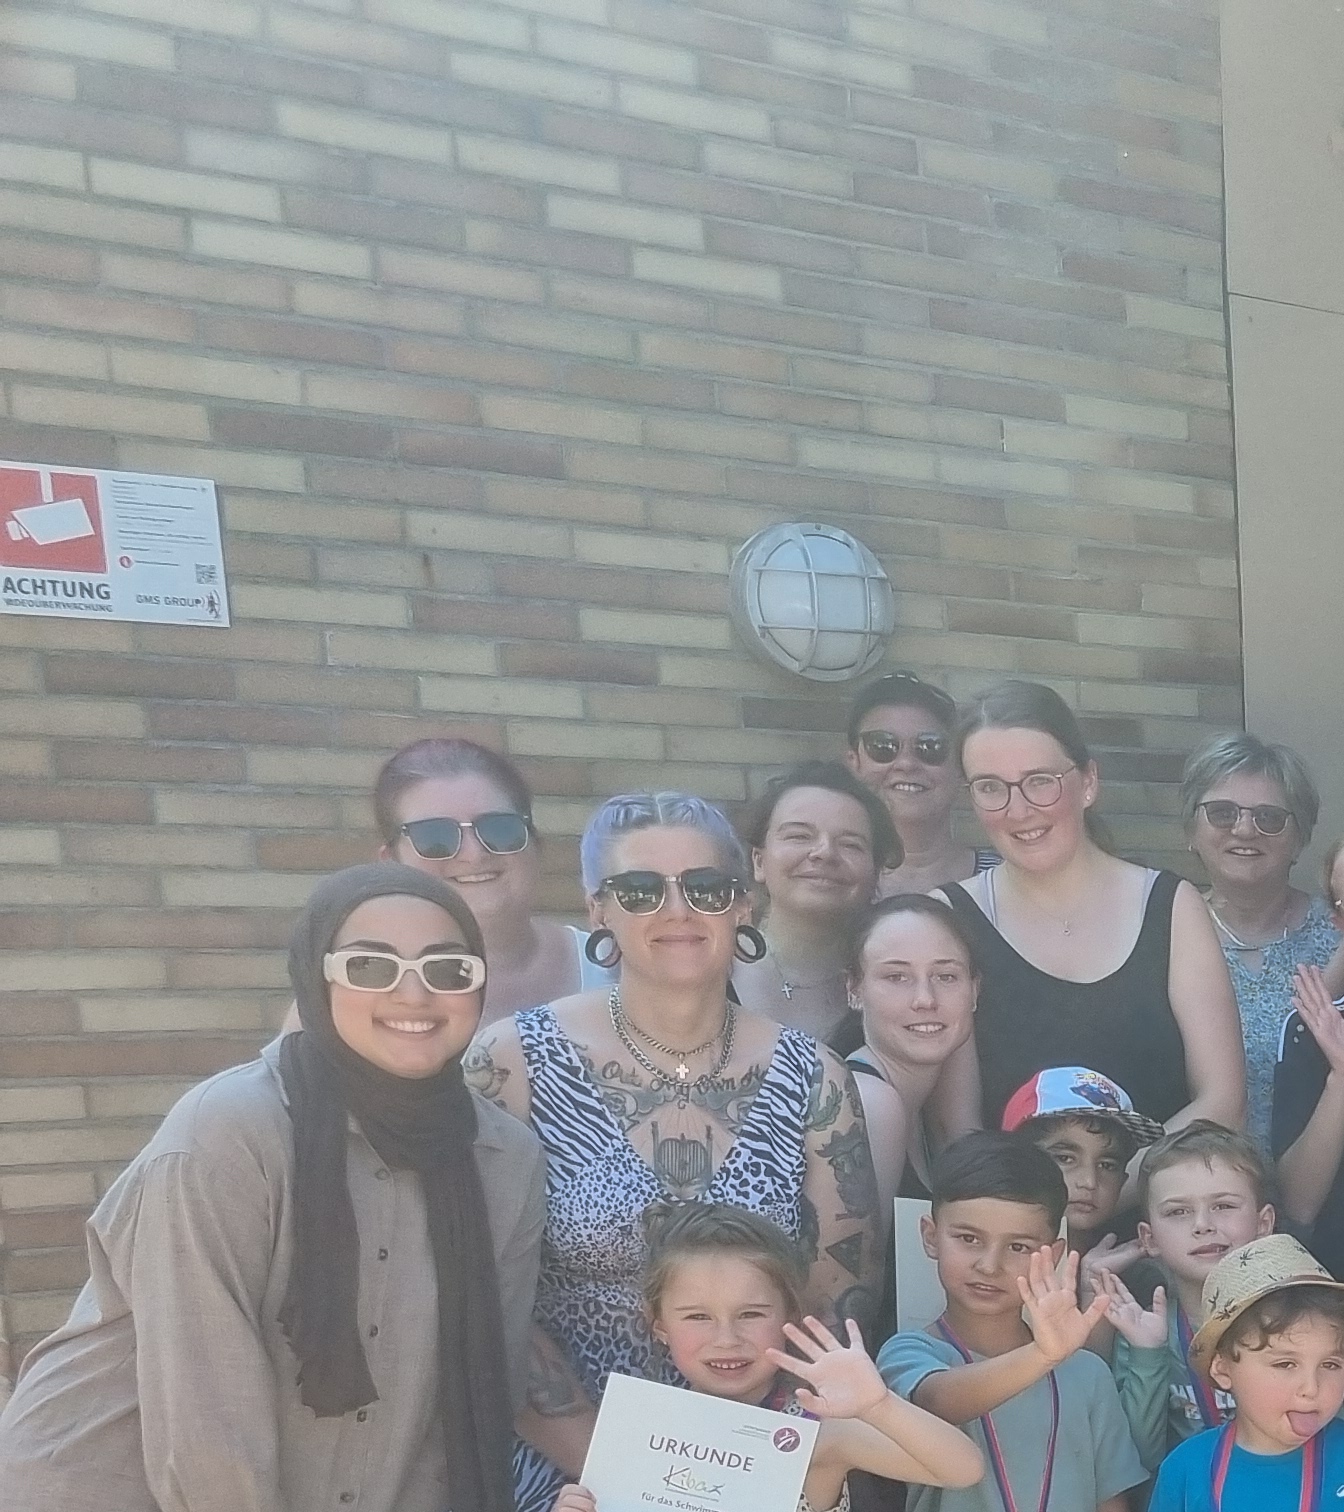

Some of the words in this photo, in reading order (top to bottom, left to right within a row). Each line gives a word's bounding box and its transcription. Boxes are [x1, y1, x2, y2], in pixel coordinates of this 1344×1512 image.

[3, 576, 111, 600] ACHTUNG
[649, 1434, 755, 1473] URKUNDE
[641, 1491, 655, 1504] für
[657, 1494, 673, 1508] das
